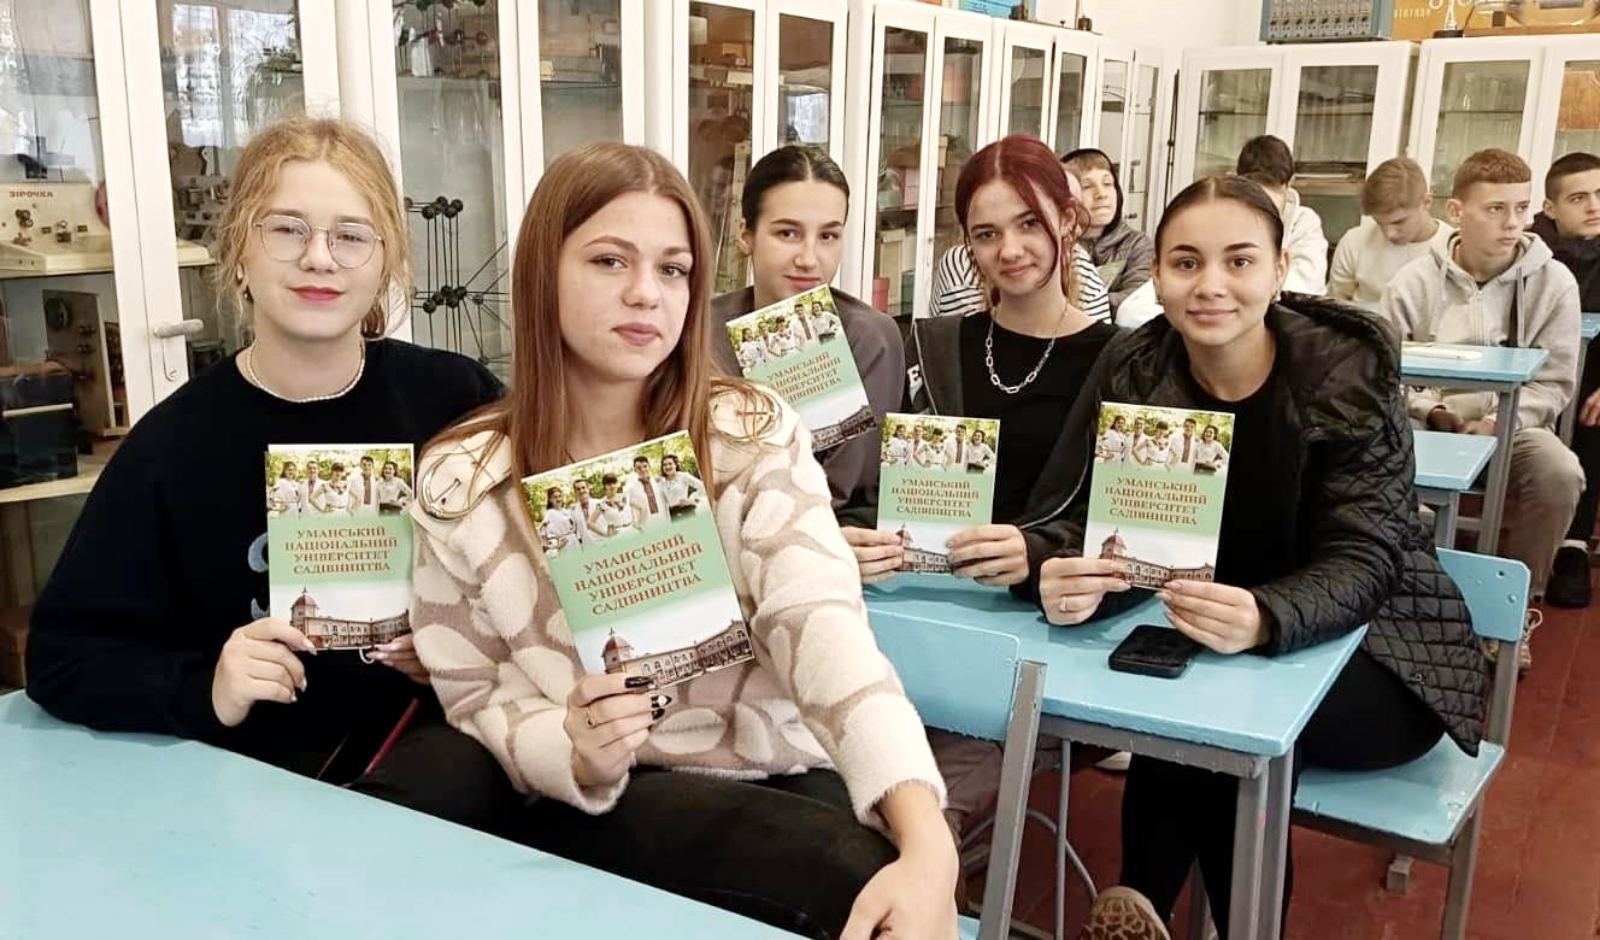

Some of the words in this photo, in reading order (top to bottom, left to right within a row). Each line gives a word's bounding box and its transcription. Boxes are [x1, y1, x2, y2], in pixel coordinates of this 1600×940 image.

[901, 478, 971, 489] УМАНСЬКИЙ
[1117, 477, 1197, 493] УМАНСЬКИЙ
[892, 487, 979, 499] НАЦІОНАЛЬНИЙ
[1105, 486, 1207, 505] НАЦІОНАЛЬНИЙ
[898, 497, 971, 508] УНІВЕРСИТЕТ
[1111, 497, 1197, 514] УНІВЕРСИТЕТ
[896, 505, 972, 518] САДІВНИЦТВА
[1109, 508, 1197, 525] САДІВНИЦТВА
[297, 526, 385, 539] УМАНСЬКИЙ
[285, 537, 398, 551] НАЦІОНАЛЬНИЙ
[294, 550, 388, 562] УНІВЕРСИТЕТ
[583, 534, 685, 575] УМАНСЬКИЙ
[293, 562, 390, 574] САДІВНИЦТВА
[575, 542, 702, 592] НАЦІОНАЛЬНИЙ
[589, 560, 696, 602] УНІВЕРСИТЕТ
[592, 573, 702, 615] САДІВНИЦТВА
